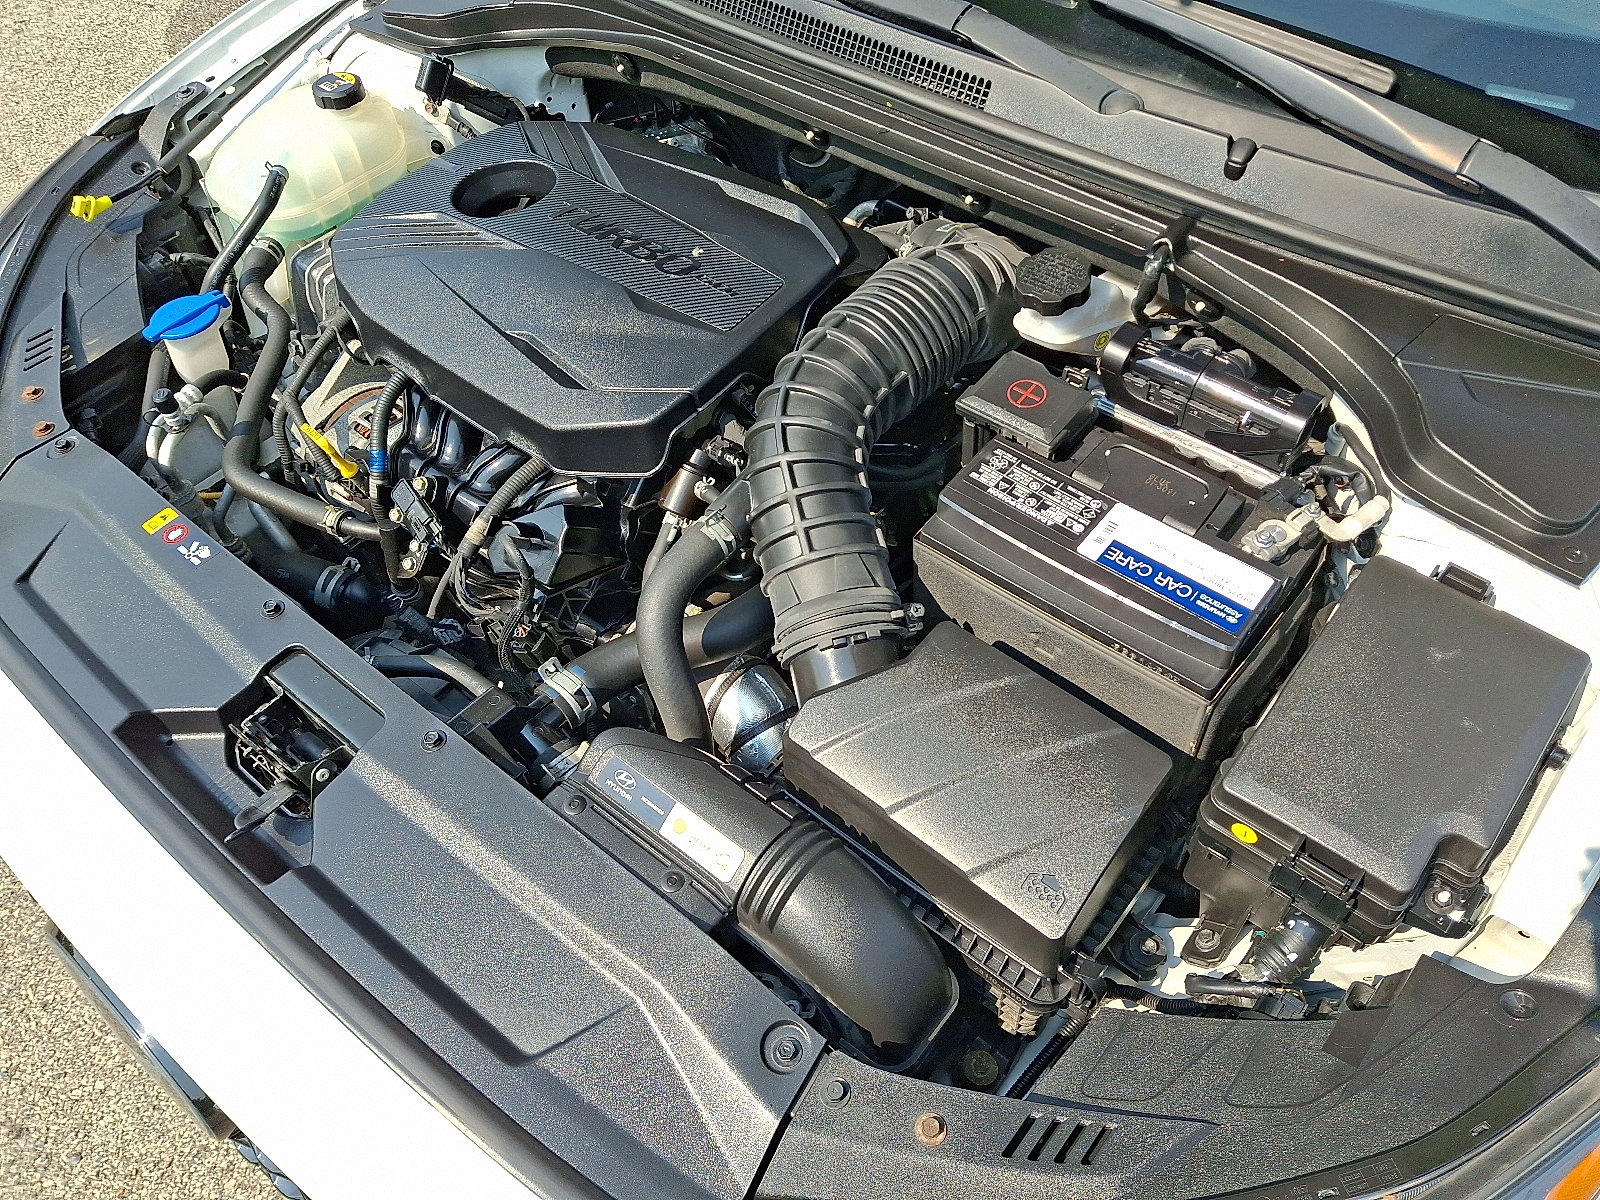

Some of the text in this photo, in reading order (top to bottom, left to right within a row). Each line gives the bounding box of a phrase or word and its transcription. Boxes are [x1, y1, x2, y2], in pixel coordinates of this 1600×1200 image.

[549, 201, 702, 278] TURBO
[1104, 546, 1152, 577] CARE
[1154, 571, 1192, 598] CAR
[1200, 593, 1244, 619] Assurance
[605, 778, 633, 802] HYUNDAI
